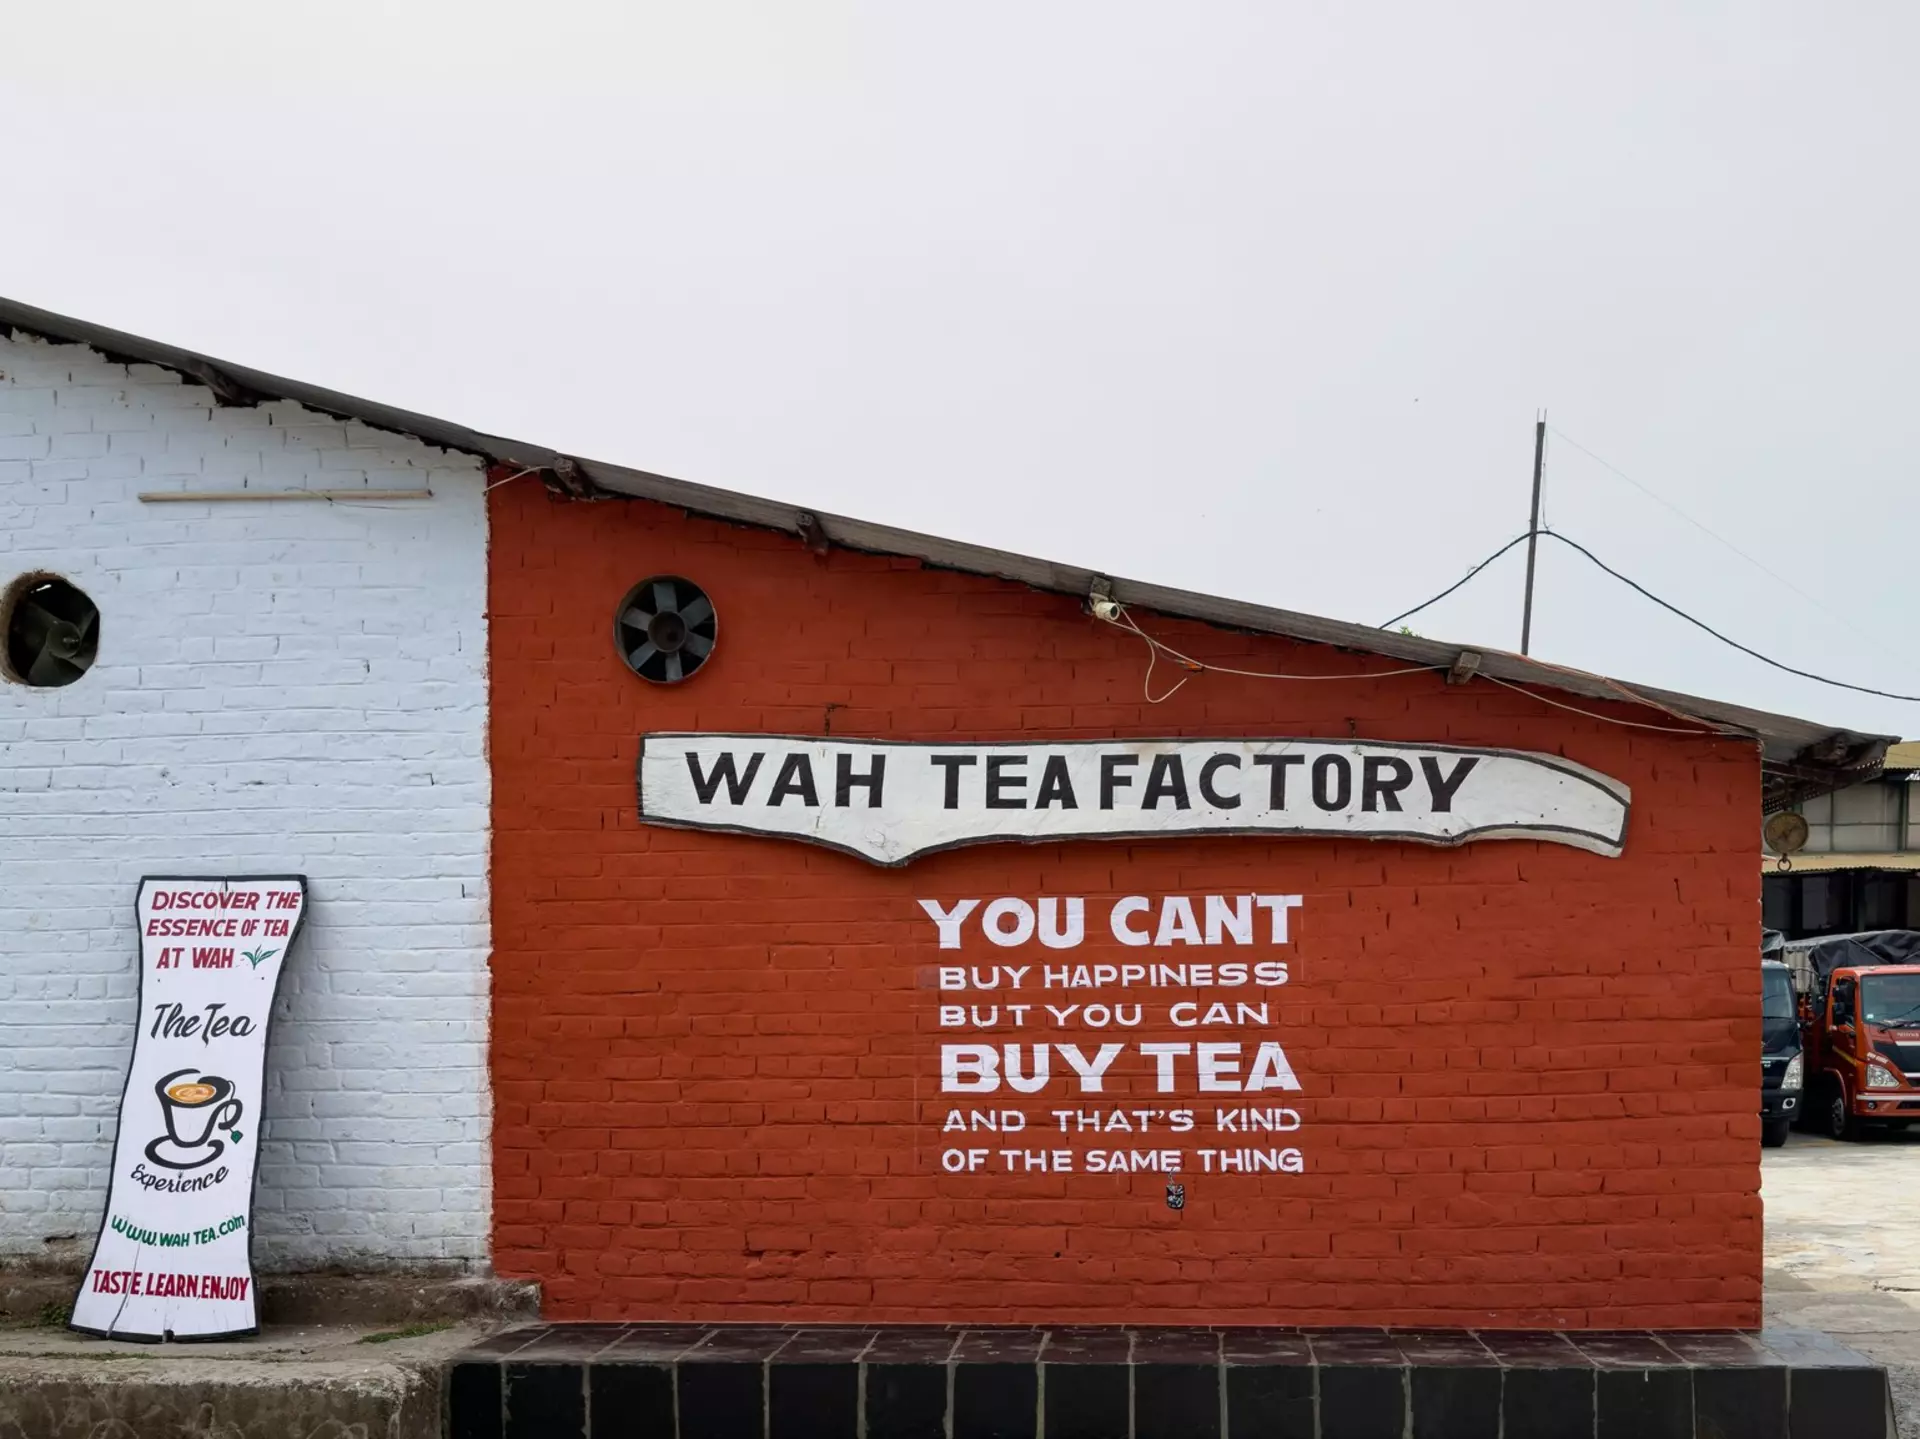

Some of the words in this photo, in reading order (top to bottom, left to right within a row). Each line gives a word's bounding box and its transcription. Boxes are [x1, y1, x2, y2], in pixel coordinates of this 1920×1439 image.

[685, 752, 887, 808] WAH
[931, 754, 1078, 810] TEA
[1100, 753, 1480, 813] FACTORY
[151, 891, 260, 910] DISCOVER
[266, 891, 301, 909] THE
[146, 919, 238, 937] ESSENCE
[240, 919, 260, 936] OF
[263, 919, 290, 937] TEA
[917, 897, 1085, 949] YOU
[156, 947, 185, 969] AT
[192, 947, 235, 969] WAH
[939, 966, 1031, 990] BUY
[1044, 962, 1289, 989] HAPPINESS
[150, 1002, 202, 1039] The
[201, 1002, 257, 1048] Tea
[939, 1004, 1031, 1027] BUT
[1043, 1003, 1142, 1027] YOU
[1169, 1002, 1269, 1025] CAN
[941, 1043, 1125, 1093] BUY
[1140, 1042, 1302, 1092] TEA
[942, 1109, 1026, 1132] AND
[1051, 1109, 1195, 1132] THAT'S
[1216, 1108, 1301, 1132] KIND
[941, 1148, 989, 1172] OF
[999, 1149, 1073, 1172] THE
[1085, 1150, 1181, 1172] SAME
[1197, 1148, 1304, 1173] THING
[131, 1163, 229, 1193] Experience
